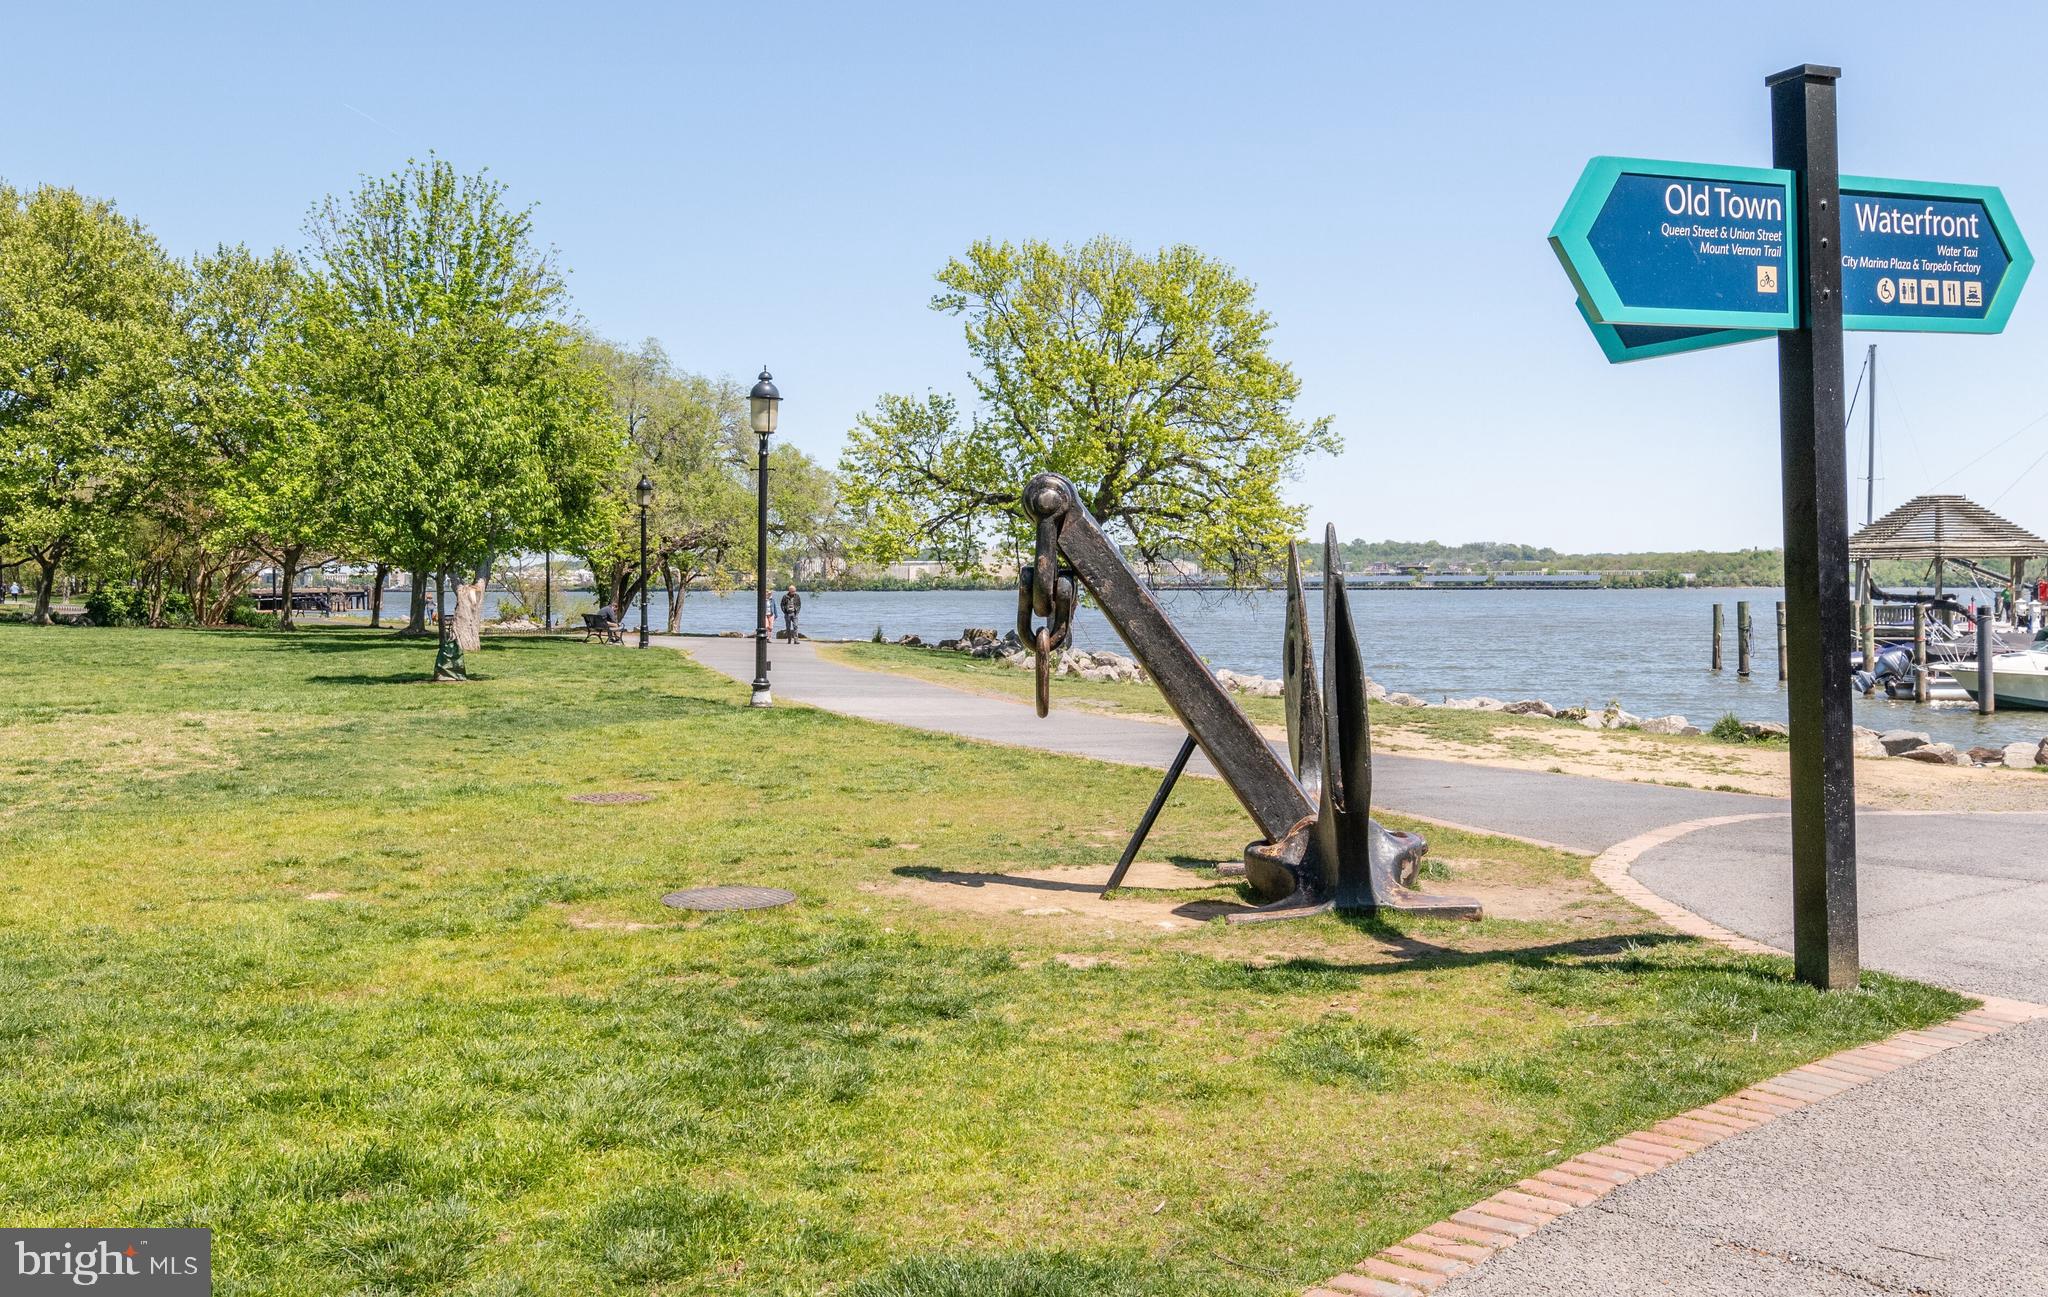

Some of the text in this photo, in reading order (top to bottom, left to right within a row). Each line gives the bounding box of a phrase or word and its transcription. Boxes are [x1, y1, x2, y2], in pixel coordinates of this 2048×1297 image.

[1665, 184, 1782, 221] Old Town
[1855, 202, 1979, 239] Waterfront
[1661, 222, 1782, 242] Queen Street & Union Street
[1700, 241, 1782, 257] Mount Vernon Trail
[1937, 245, 1978, 258] Water Taxi
[1842, 255, 1981, 276] City Marina Plaza & Torpedo Factory
